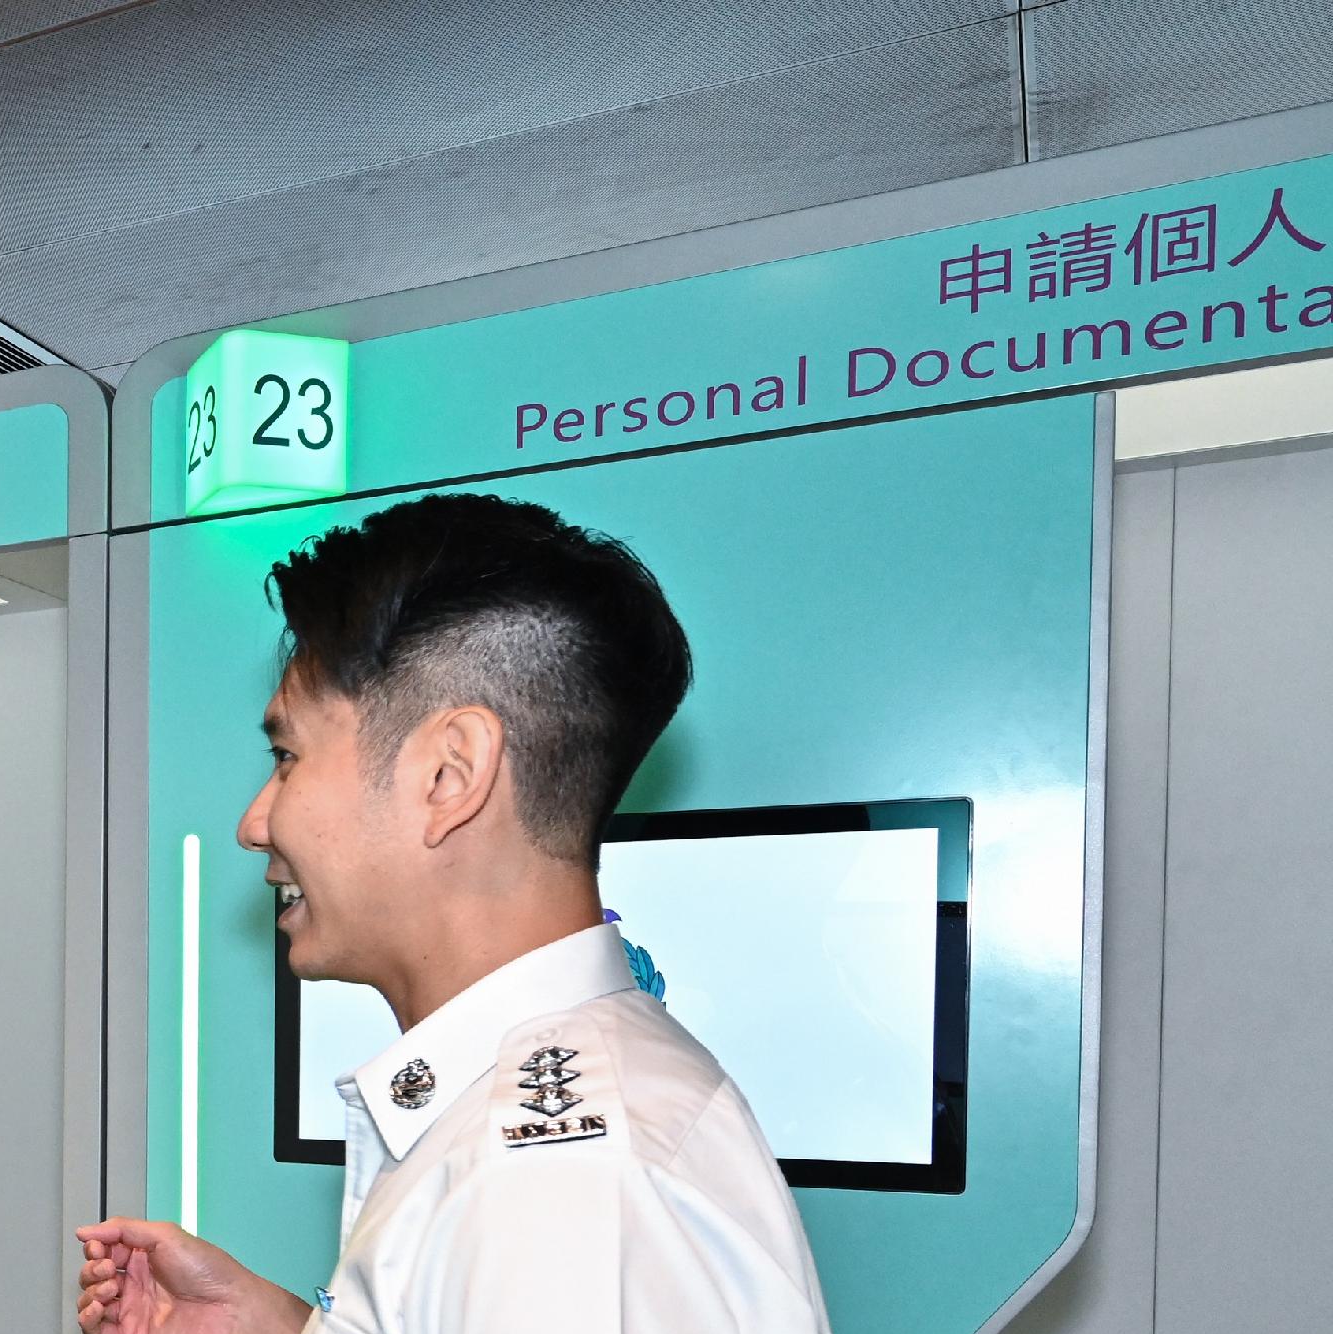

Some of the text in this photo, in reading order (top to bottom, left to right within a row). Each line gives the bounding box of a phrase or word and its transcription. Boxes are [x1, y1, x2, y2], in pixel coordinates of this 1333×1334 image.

[939, 188, 1327, 314] 申請個人
[252, 373, 334, 451] 23
[516, 284, 1333, 449] Personal Documenta
[187, 384, 217, 475] 23
